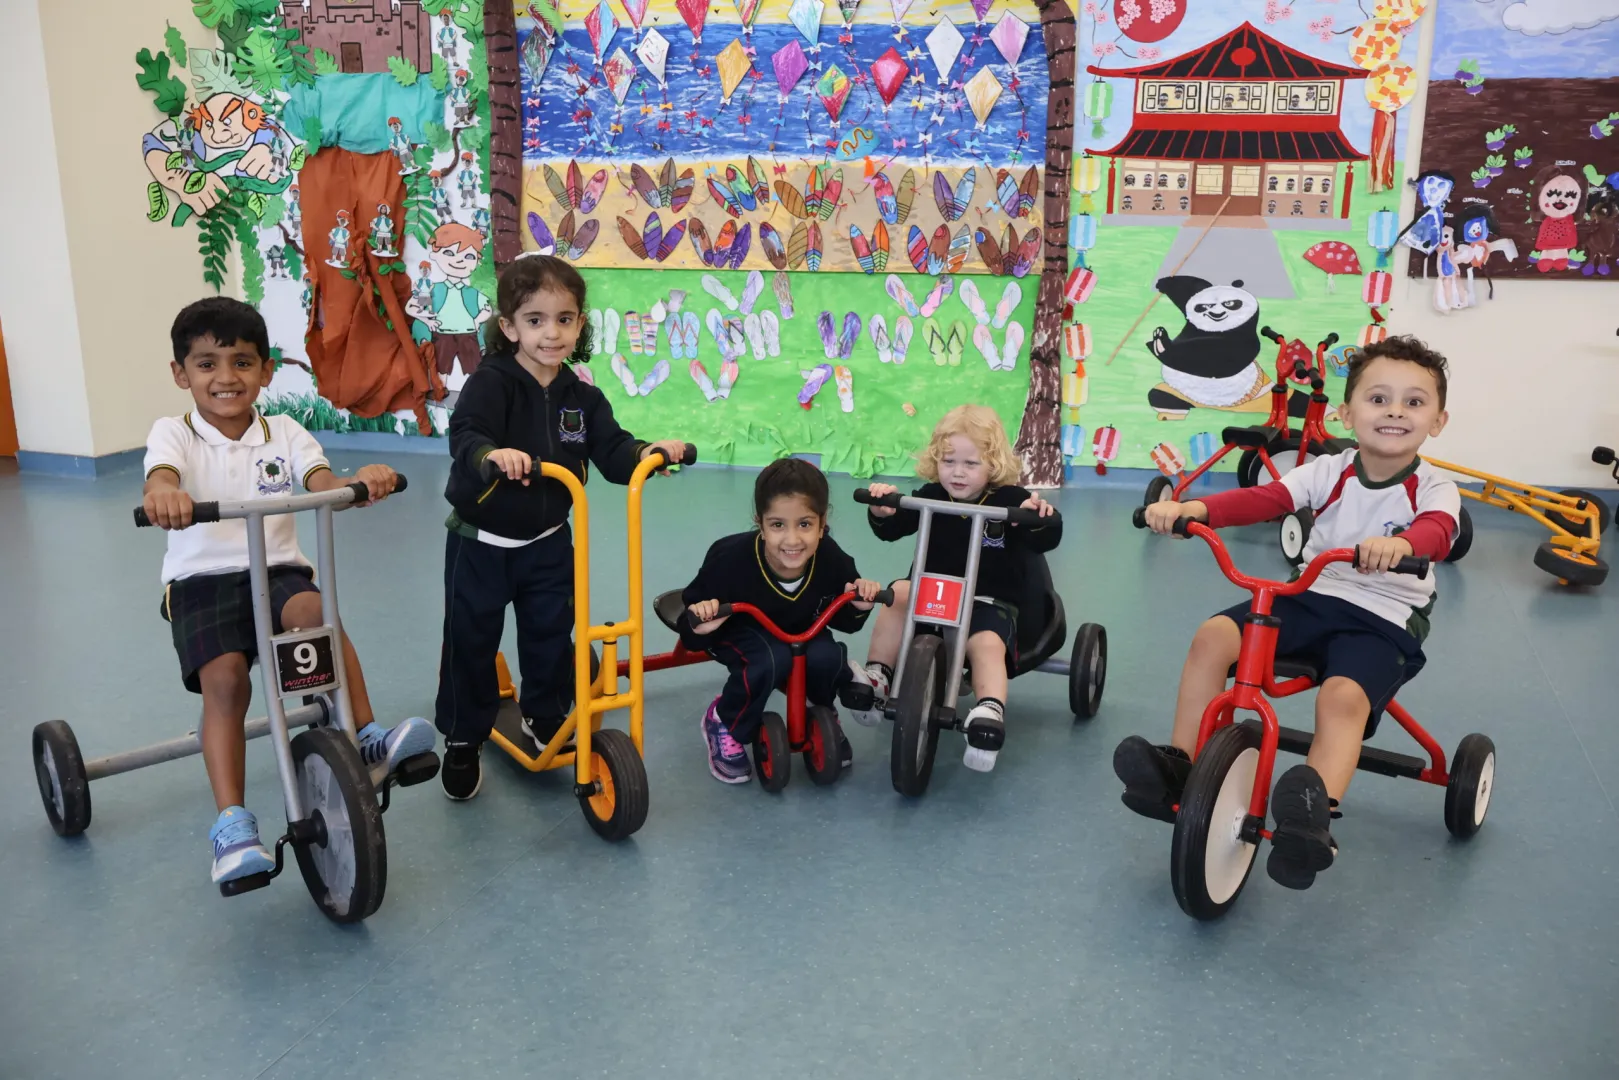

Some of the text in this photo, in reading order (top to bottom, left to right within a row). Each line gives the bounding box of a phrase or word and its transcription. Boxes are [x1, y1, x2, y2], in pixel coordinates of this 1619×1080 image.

[936, 581, 944, 601] 1
[293, 642, 318, 675] 9
[284, 673, 331, 687] winther
